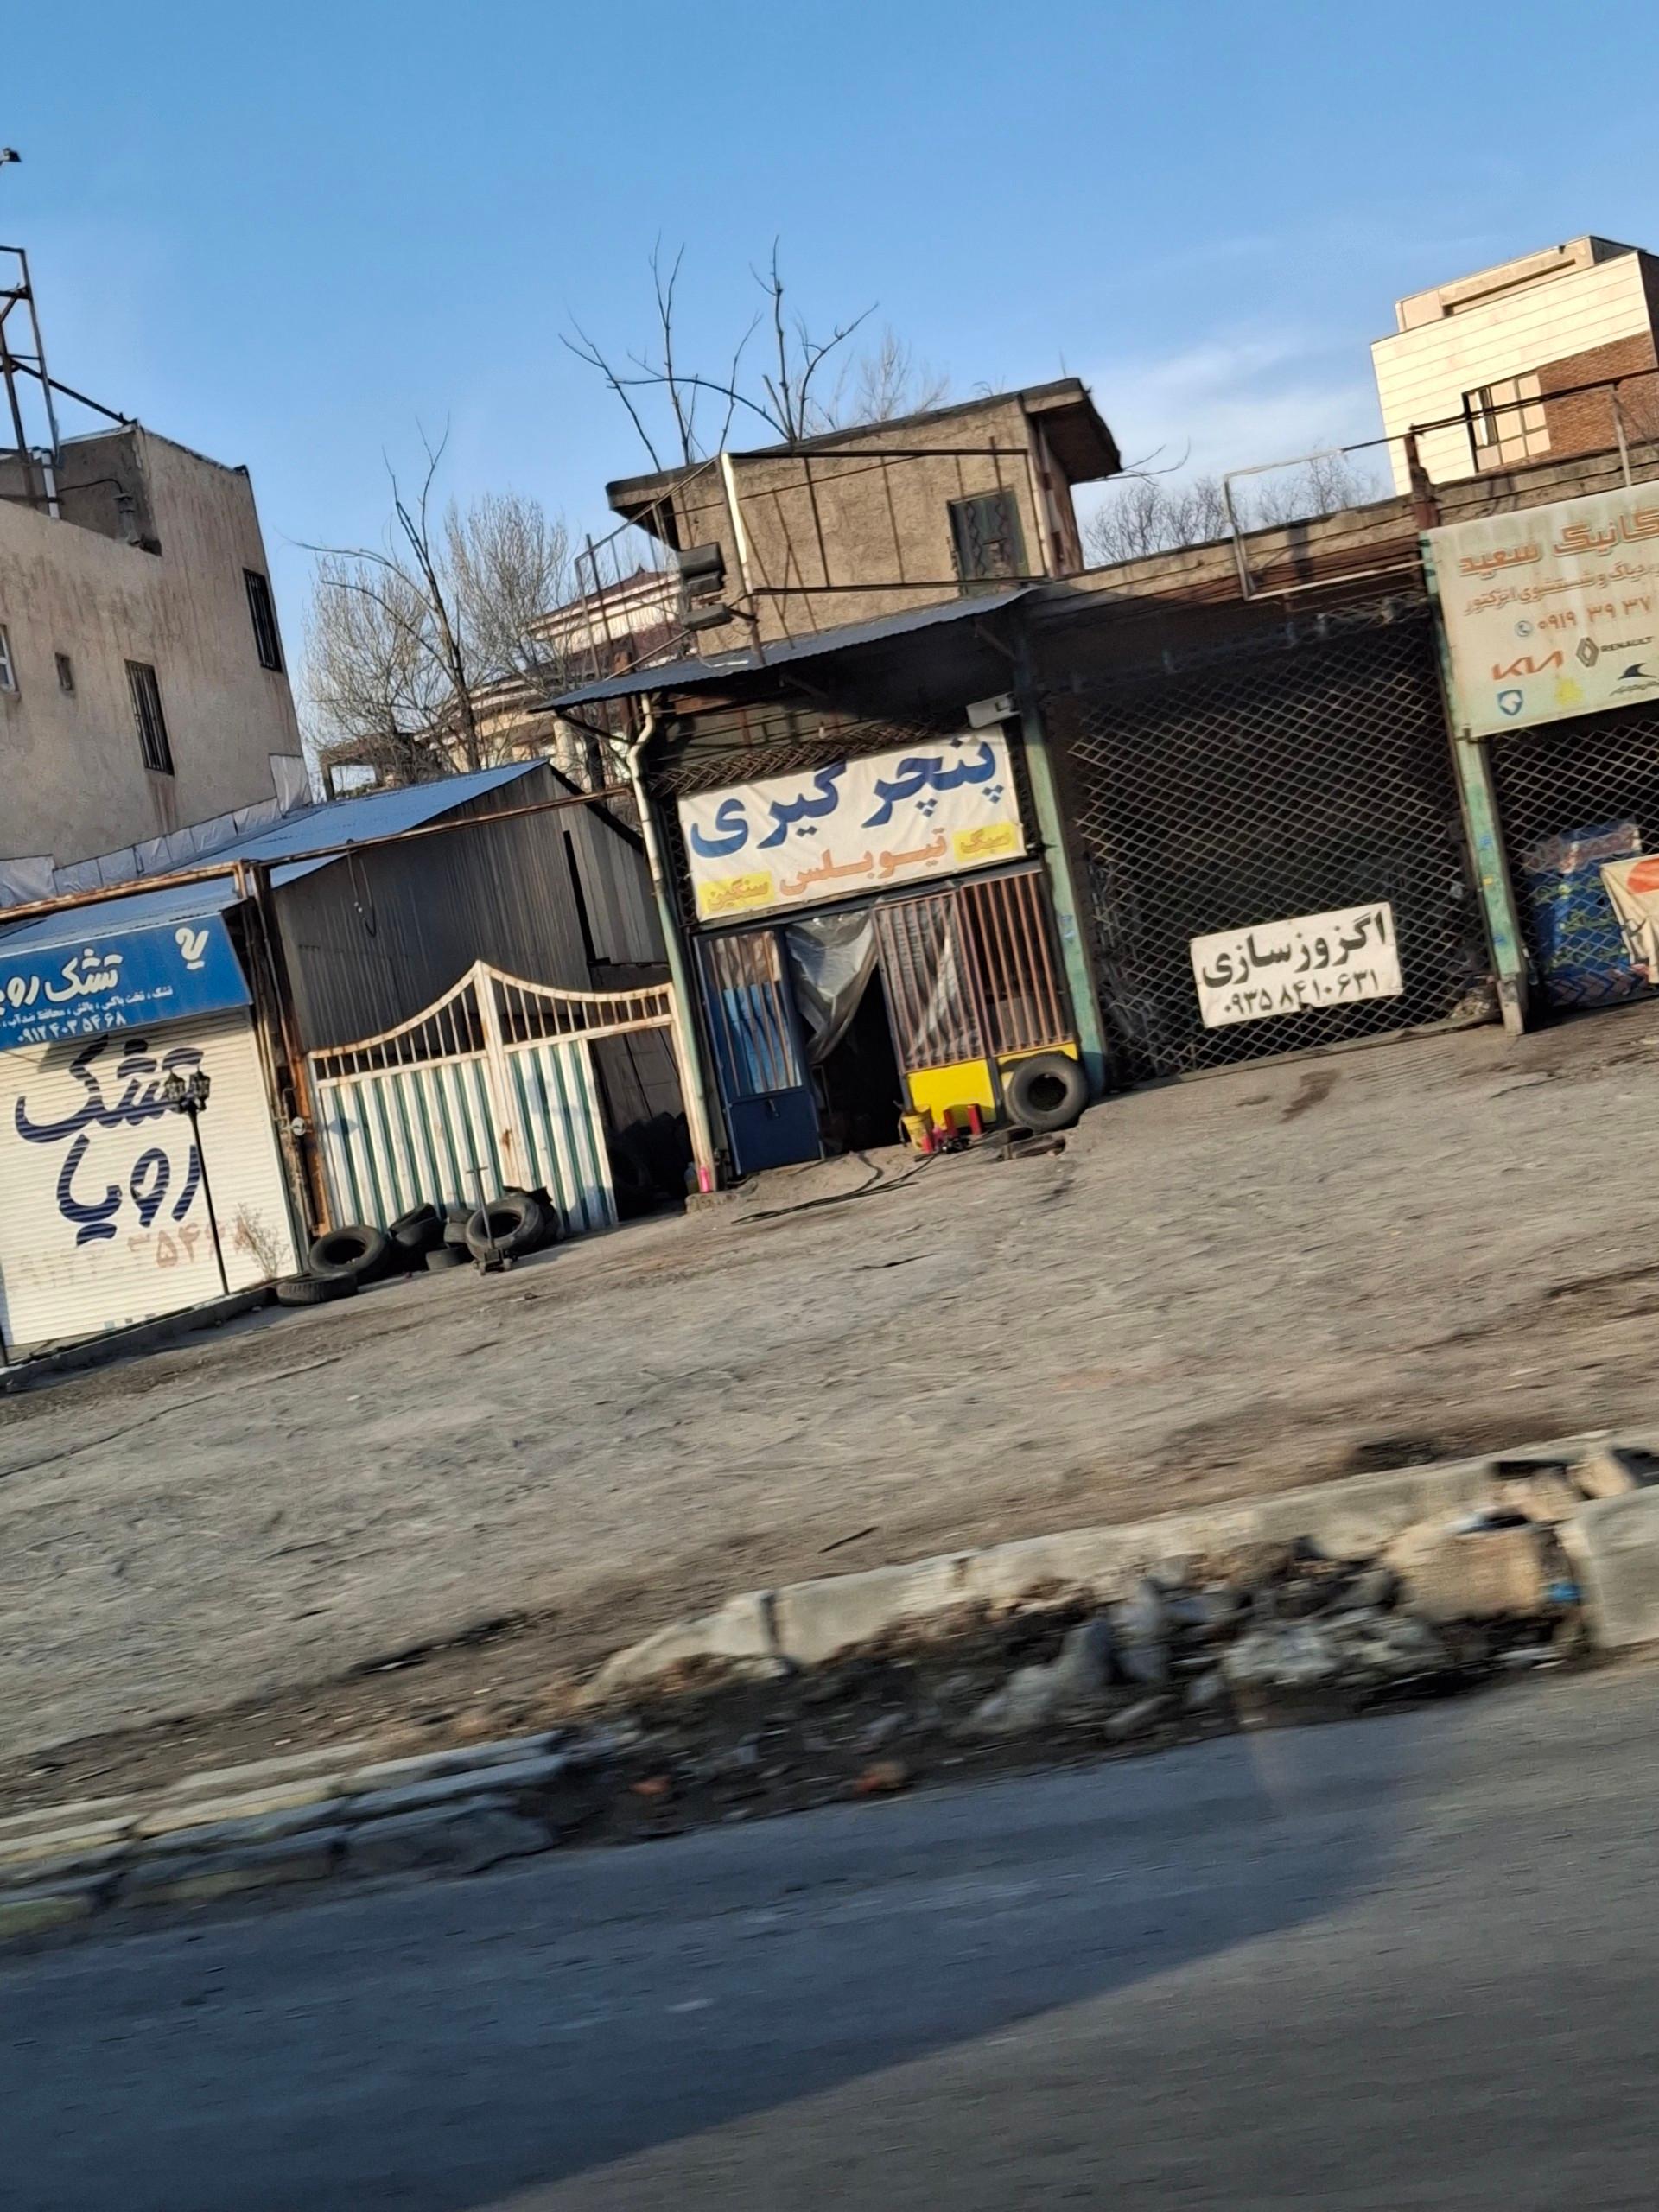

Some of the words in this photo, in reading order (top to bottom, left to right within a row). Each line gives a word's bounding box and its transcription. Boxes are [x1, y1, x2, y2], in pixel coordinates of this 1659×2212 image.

[1553, 507, 1659, 557] کانیک
[1459, 542, 1542, 579] سعید
[1600, 636, 1654, 652] RENAULT
[690, 757, 847, 858] گیری
[861, 736, 1004, 829] پنچر
[779, 827, 947, 896] تیوبلس
[707, 878, 769, 911] سنگین
[45, 948, 124, 1002] تشک
[56, 1134, 200, 1247] رویا
